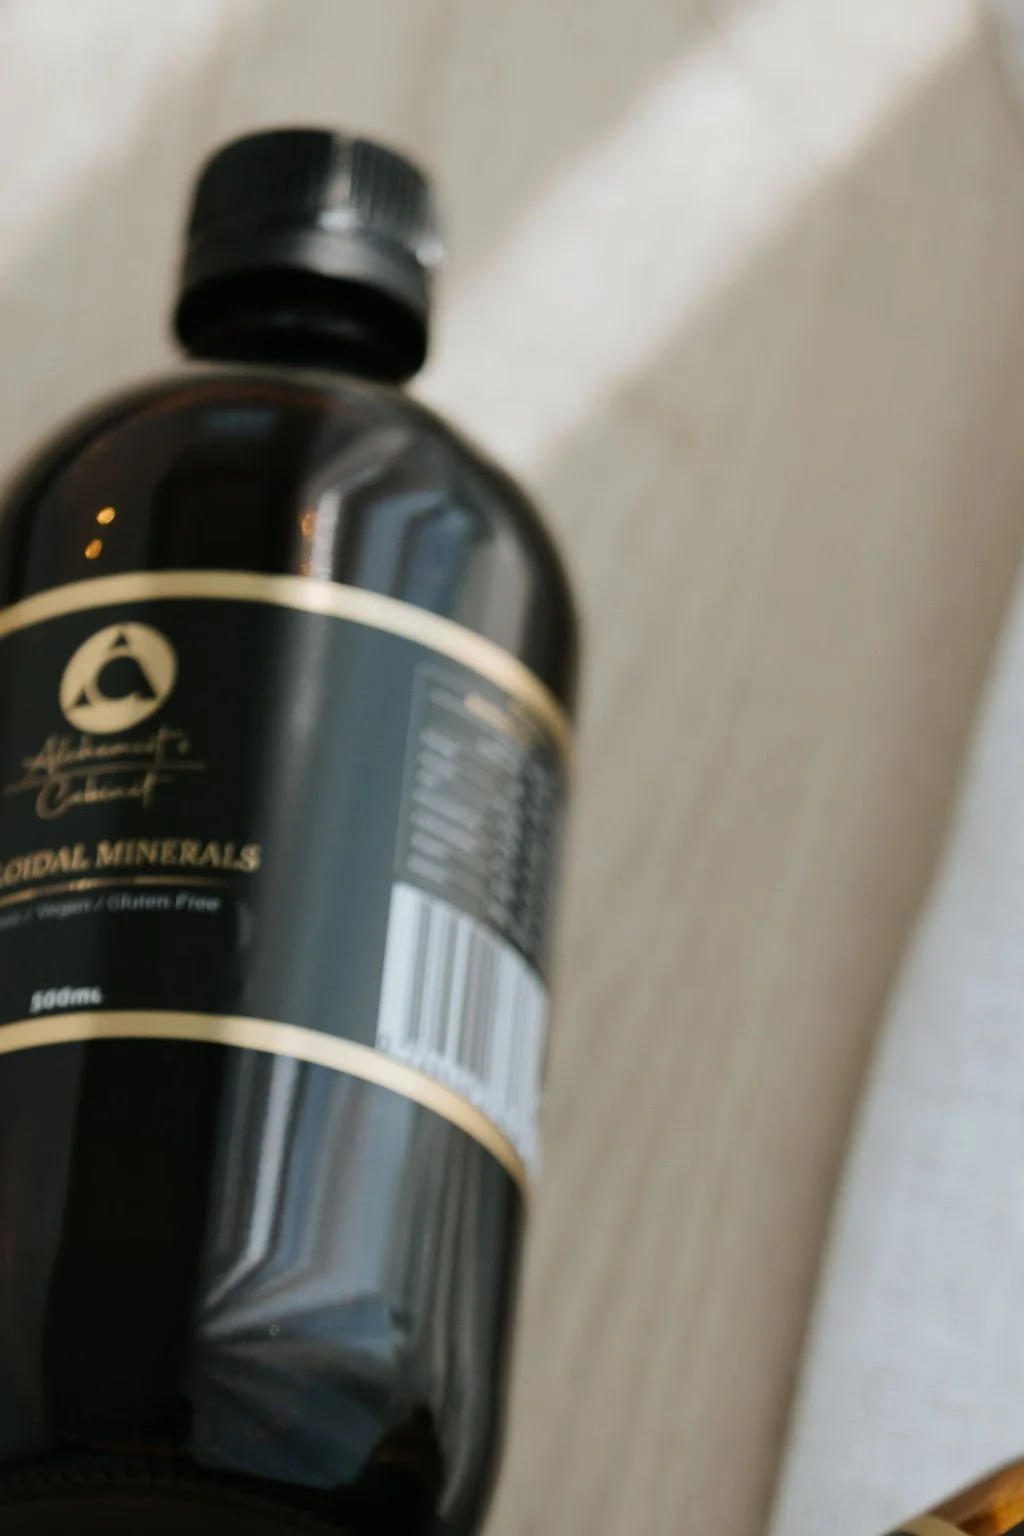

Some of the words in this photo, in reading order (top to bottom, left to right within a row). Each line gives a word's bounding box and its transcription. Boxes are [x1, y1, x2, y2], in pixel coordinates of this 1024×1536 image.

[0, 842, 90, 888] OIDAL
[96, 839, 262, 874] MINERALS
[106, 892, 169, 912] Gluten
[175, 891, 220, 913] Free
